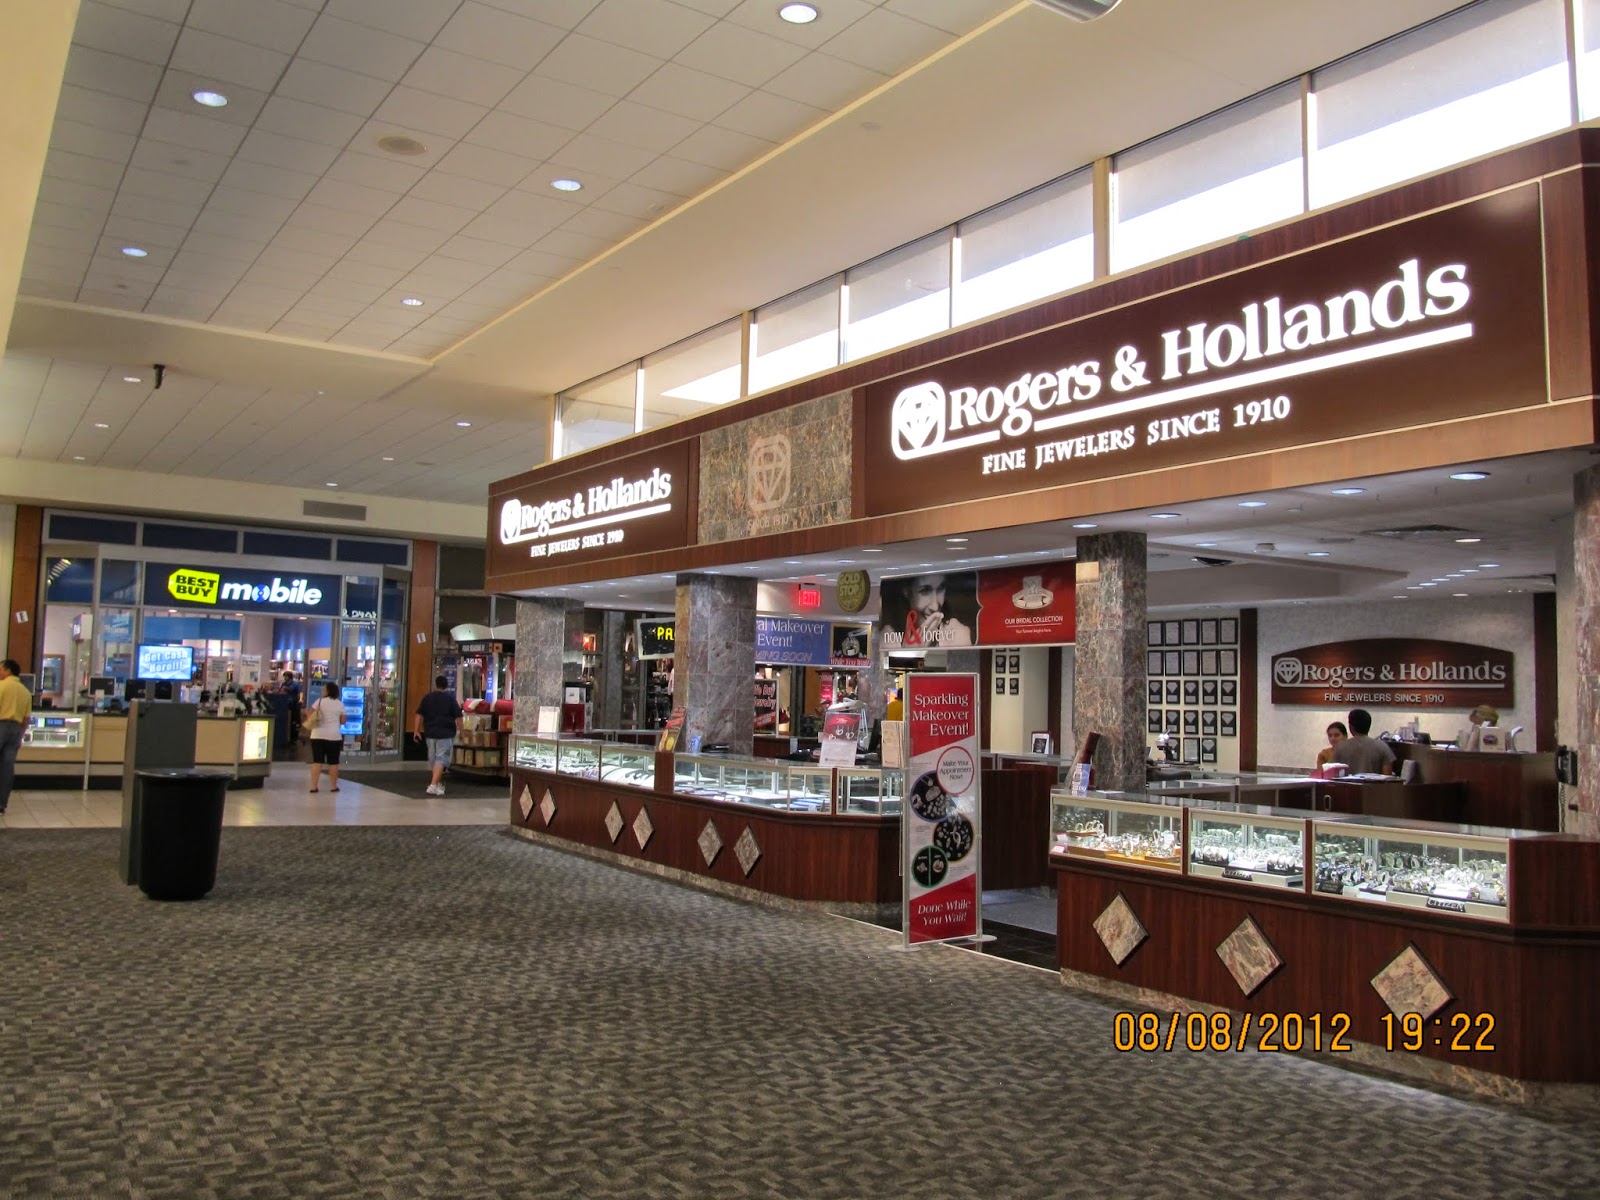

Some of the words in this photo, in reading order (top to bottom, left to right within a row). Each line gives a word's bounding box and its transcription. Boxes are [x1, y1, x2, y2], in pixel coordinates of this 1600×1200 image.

[948, 360, 1101, 437] Rogers
[1110, 345, 1151, 392] &
[1161, 258, 1471, 381] Hollands
[982, 448, 1027, 475] FINE
[1034, 425, 1136, 469] JEWELERS
[1147, 408, 1221, 446] SINCE
[1233, 395, 1291, 428] 1910
[521, 498, 572, 537] Rogers
[572, 492, 586, 519] &
[587, 467, 672, 515] Hollands
[530, 544, 547, 557] FINE
[548, 537, 581, 557] JEWELERS
[582, 533, 605, 549] SINCE
[175, 575, 217, 589] BEST
[840, 572, 860, 585] GOLD
[176, 585, 212, 597] BUY
[221, 578, 323, 605] mobile
[803, 591, 817, 605] EXIT
[840, 585, 859, 597] STOP
[657, 626, 675, 640] PA
[771, 619, 824, 634] Makeover
[757, 634, 793, 647] Event!
[884, 632, 904, 644] now
[922, 627, 956, 643] forever
[781, 651, 812, 663] SOON
[1303, 663, 1376, 688] Rogers
[1380, 664, 1395, 681] &
[1399, 660, 1507, 682] Hollands
[914, 693, 969, 708] Sparkling
[1324, 692, 1343, 702] FINE
[1345, 693, 1392, 703] JEWELERS
[1394, 693, 1422, 703] SINCE
[1425, 694, 1445, 704] 1910
[912, 709, 969, 721] Makeover
[930, 723, 969, 736] Event!
[917, 901, 943, 915] Done
[946, 898, 972, 912] While
[1427, 898, 1465, 912] CITIZEN
[922, 915, 942, 926] You
[945, 911, 967, 925] Wait!
